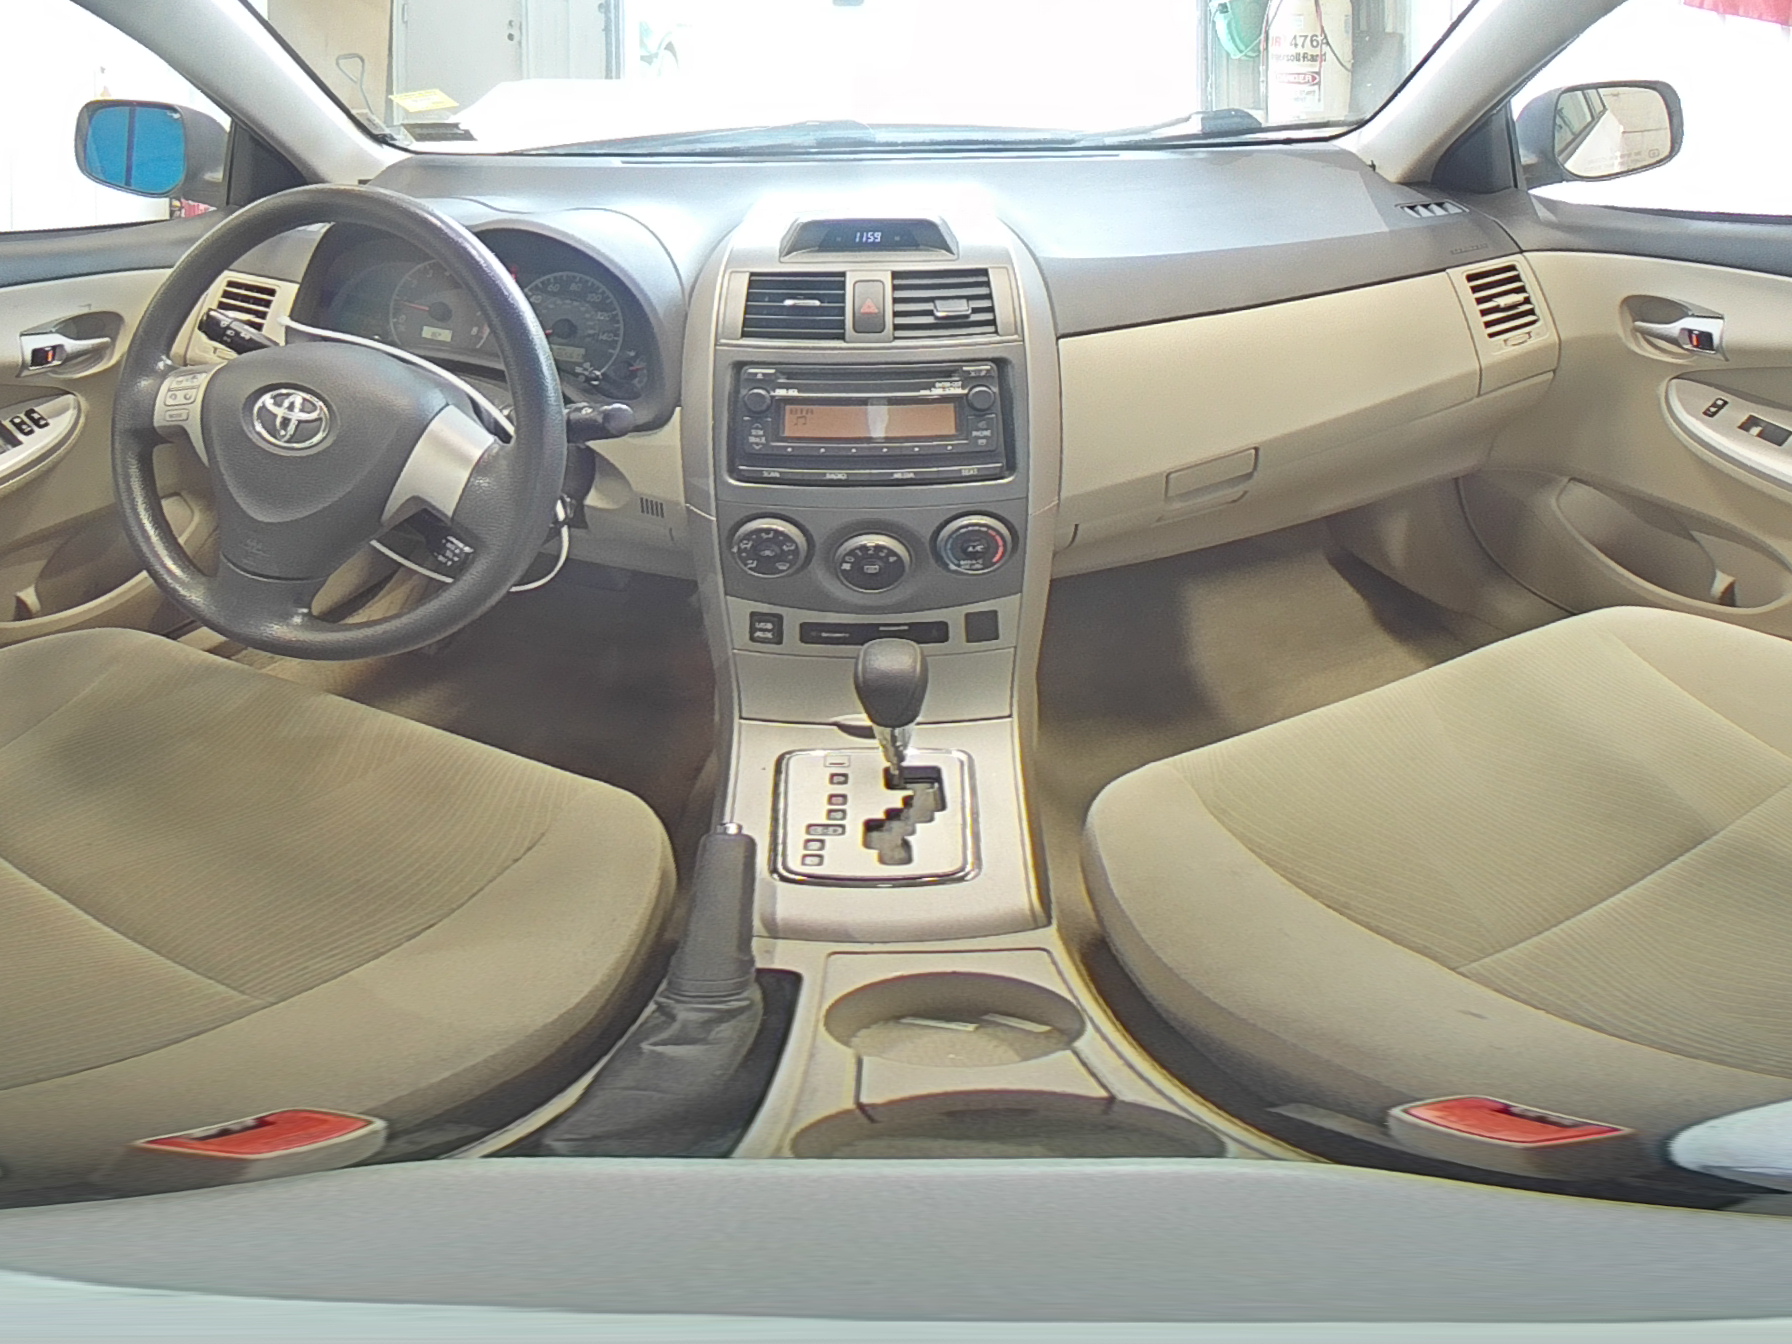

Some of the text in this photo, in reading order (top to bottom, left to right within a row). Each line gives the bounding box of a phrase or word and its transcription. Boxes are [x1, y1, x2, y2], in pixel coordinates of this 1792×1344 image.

[1277, 74, 1312, 84] NGER
[972, 429, 991, 437] PHONE
[826, 472, 847, 480] RADIO
